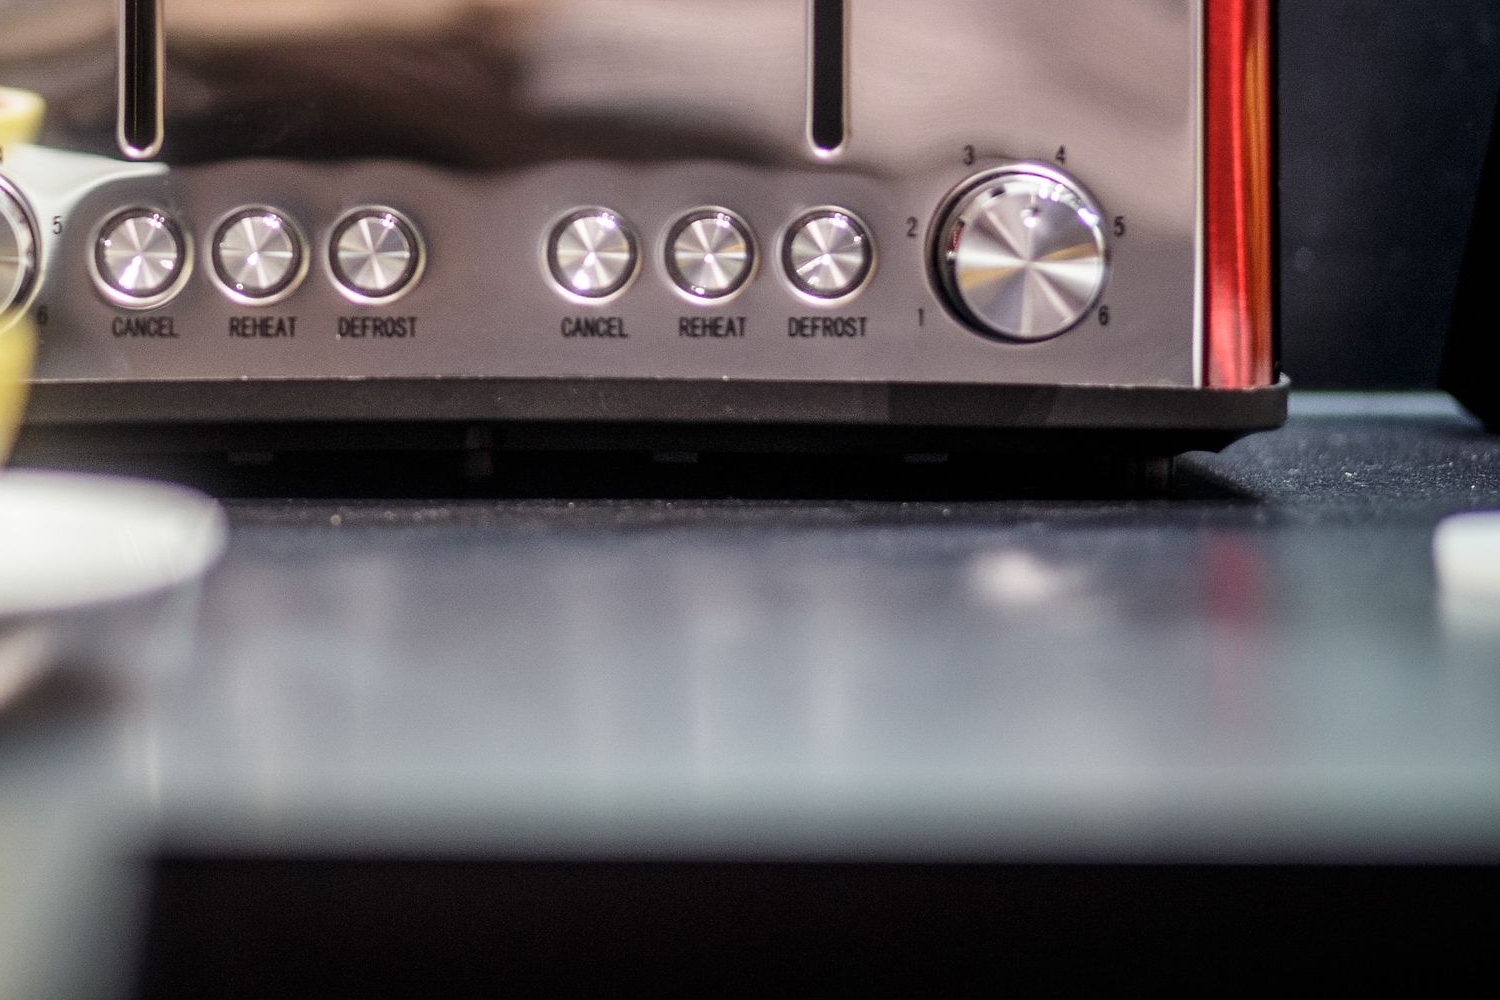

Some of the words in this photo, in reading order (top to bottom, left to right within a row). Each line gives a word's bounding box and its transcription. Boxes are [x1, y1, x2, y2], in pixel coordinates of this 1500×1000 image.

[963, 145, 975, 166] 3
[1056, 145, 1066, 164] 4
[52, 215, 63, 235] 5
[906, 217, 918, 238] 2
[1114, 216, 1125, 236] 5
[918, 308, 924, 327] 1
[1098, 305, 1110, 326] 6
[112, 317, 180, 338] CANCEL
[229, 316, 297, 338] REHEAT
[337, 316, 417, 338] DEFROST
[561, 316, 628, 338] CANCEL
[678, 316, 747, 338] REHEAT
[788, 316, 867, 338] DEFROST
